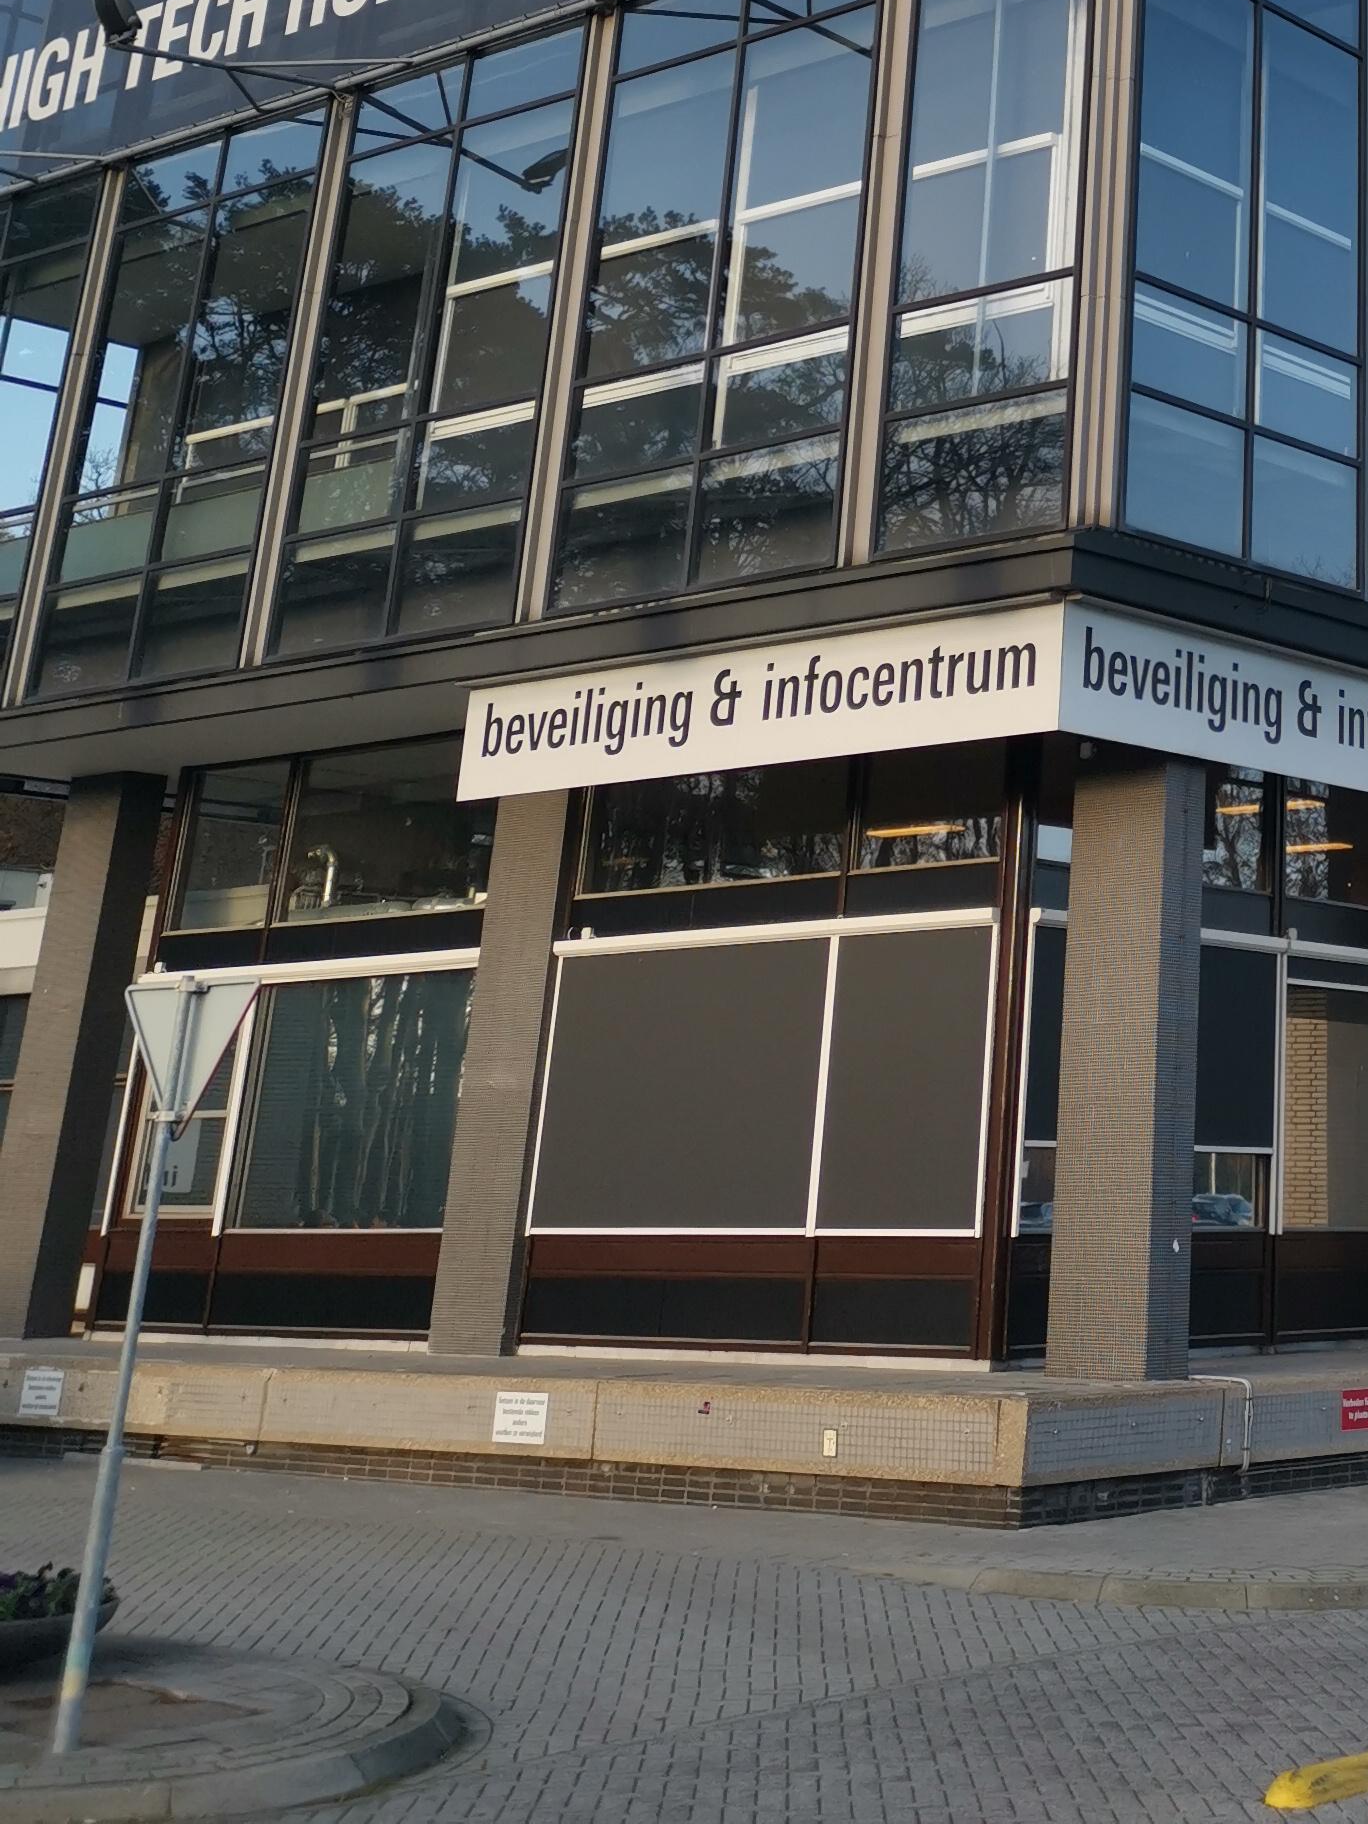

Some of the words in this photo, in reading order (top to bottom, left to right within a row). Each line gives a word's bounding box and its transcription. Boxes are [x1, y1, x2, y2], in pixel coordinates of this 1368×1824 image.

[481, 682, 694, 757] beveiliging
[710, 669, 742, 726] &
[762, 642, 1037, 721] infocentrum
[1083, 626, 1282, 745] beveiliging
[1297, 680, 1322, 738] &
